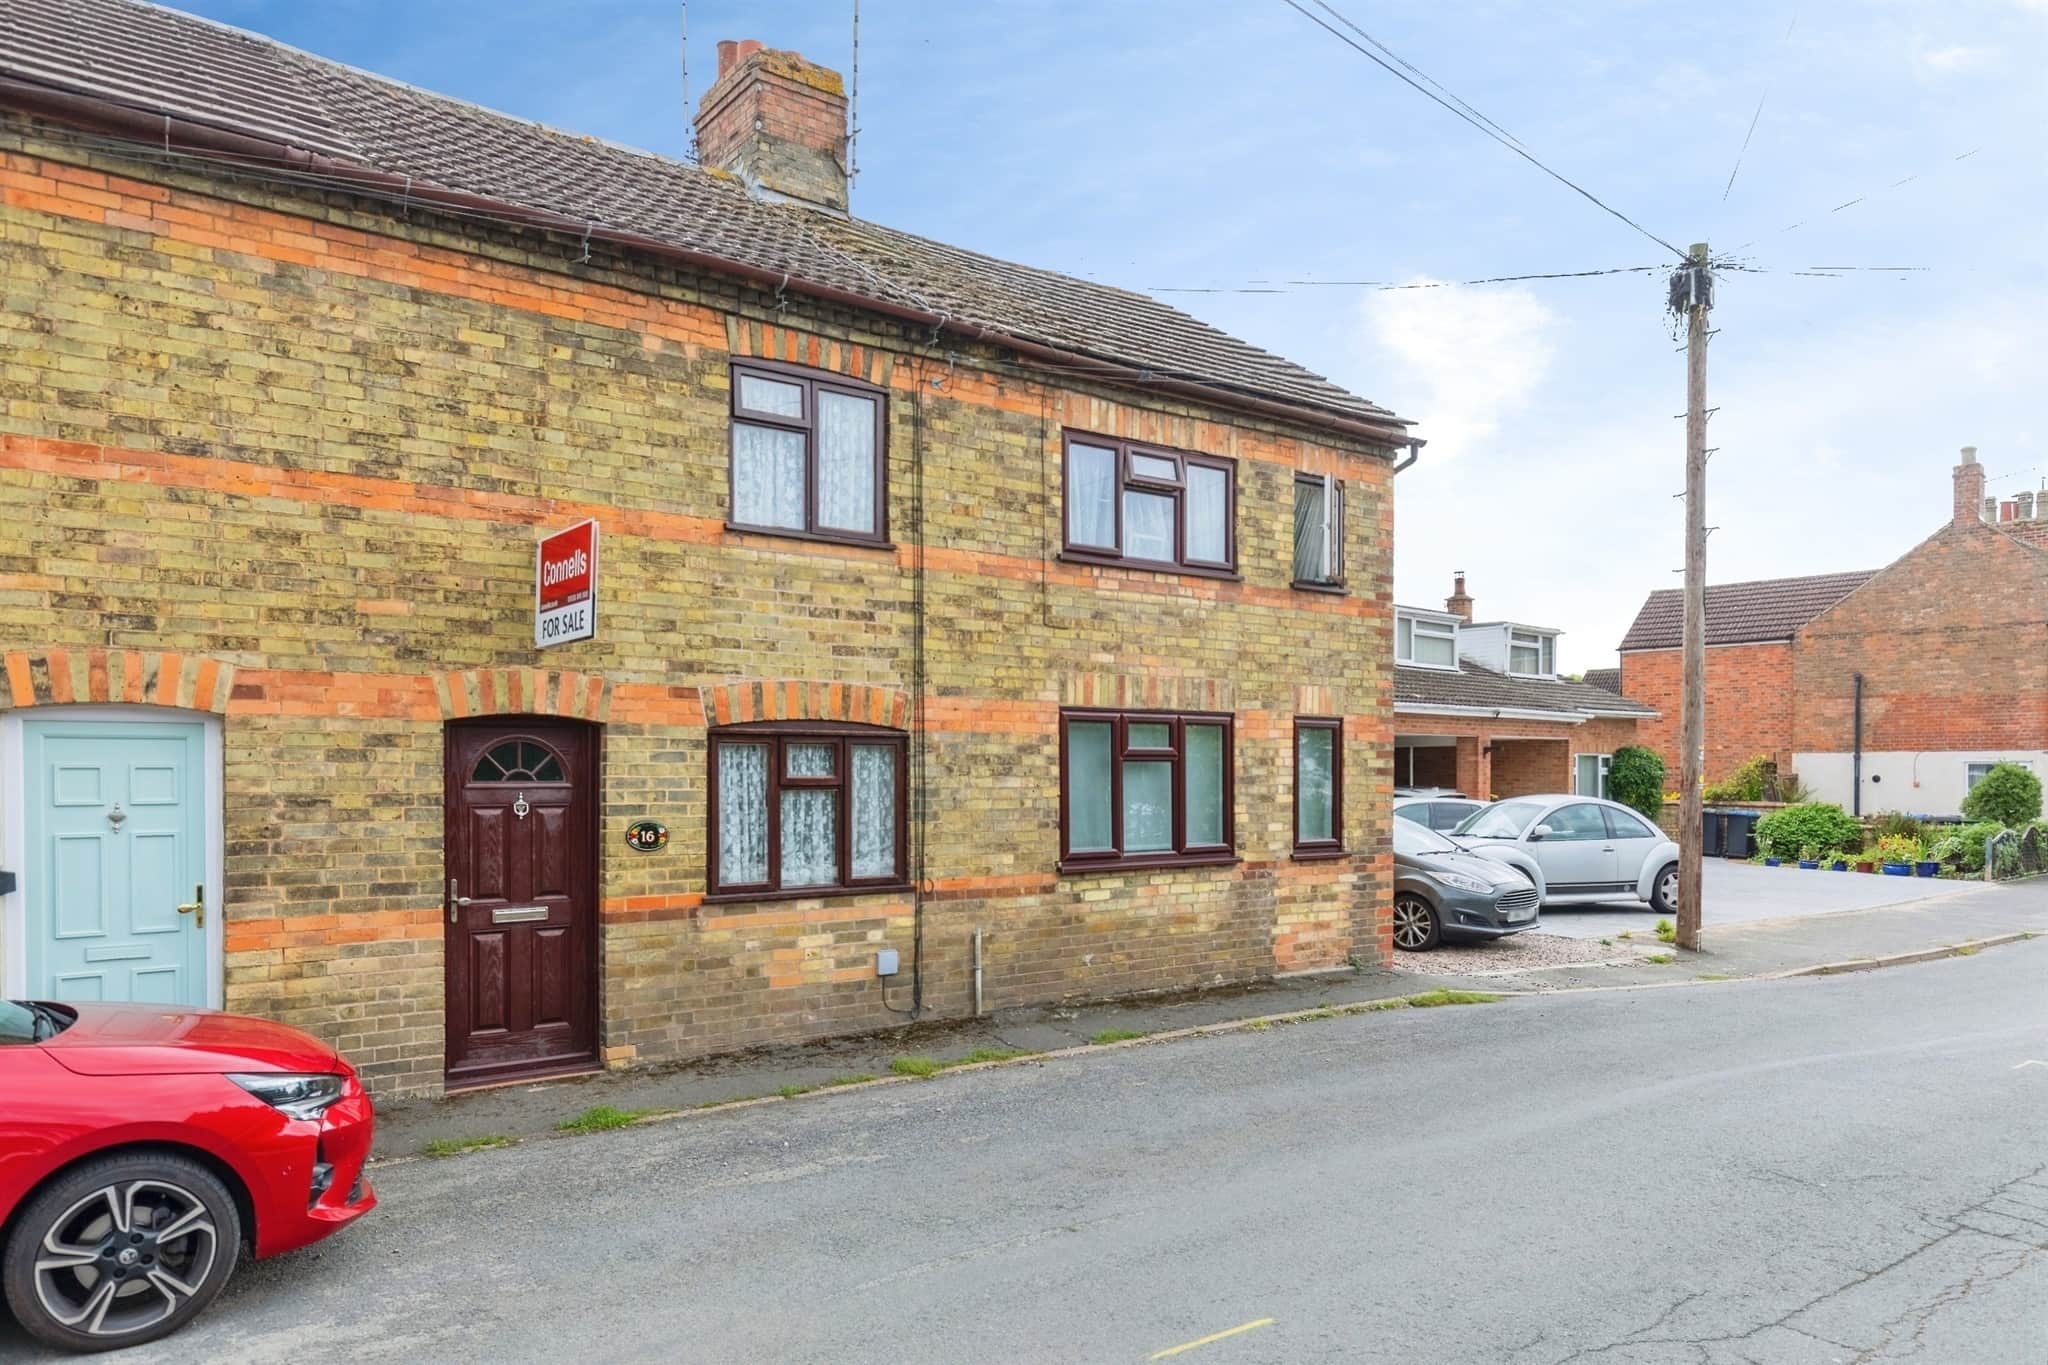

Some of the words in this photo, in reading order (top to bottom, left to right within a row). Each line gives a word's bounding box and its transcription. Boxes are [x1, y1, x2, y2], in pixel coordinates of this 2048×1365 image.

[543, 548, 587, 587] Connells
[542, 616, 560, 639] FOR
[562, 609, 584, 635] SALE
[640, 830, 655, 842] 16
